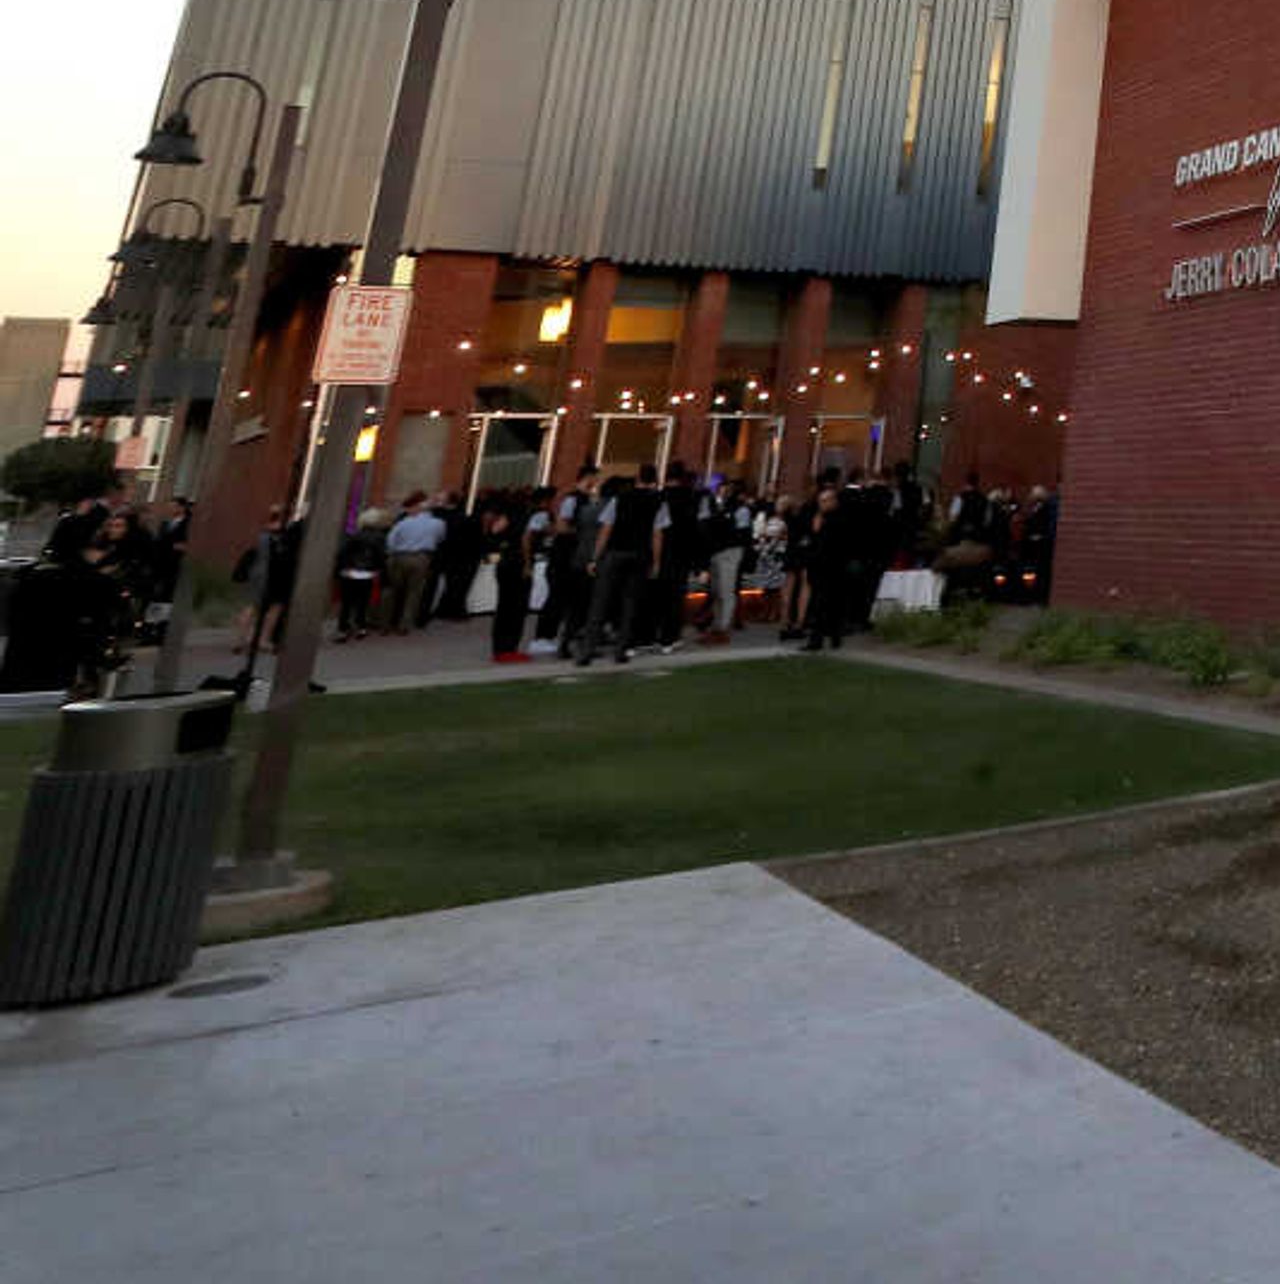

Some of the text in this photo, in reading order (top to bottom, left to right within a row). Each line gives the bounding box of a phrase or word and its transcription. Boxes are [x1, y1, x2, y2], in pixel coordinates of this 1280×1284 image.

[1176, 140, 1239, 186] GRAND
[1166, 253, 1224, 299] JERRY
[347, 293, 394, 311] FIRE
[343, 313, 392, 327] LANE
